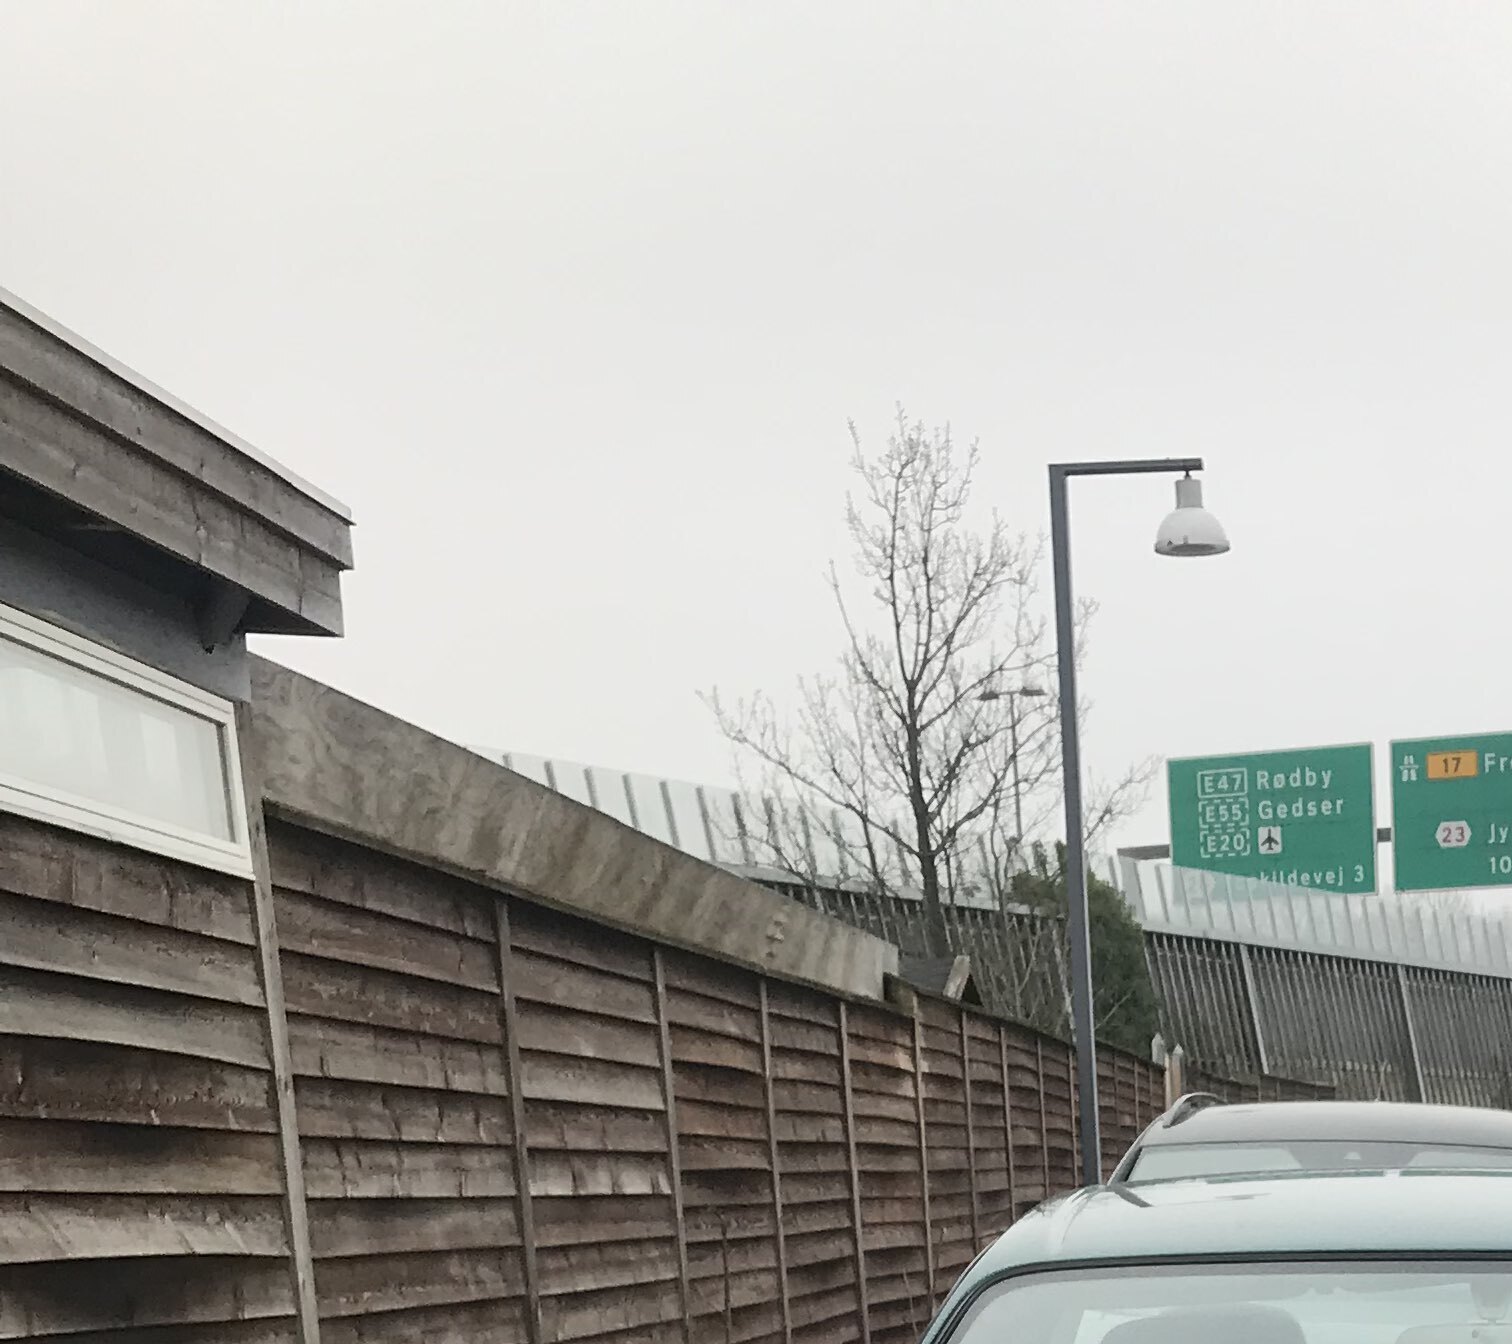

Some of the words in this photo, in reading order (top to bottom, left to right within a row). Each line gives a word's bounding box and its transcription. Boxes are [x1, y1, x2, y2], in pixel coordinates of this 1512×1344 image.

[1442, 757, 1462, 774] 17
[1203, 774, 1243, 793] E47
[1256, 767, 1332, 790] Rødby
[1205, 804, 1243, 823] E55
[1258, 797, 1344, 820] Gedser
[1207, 834, 1245, 852] E20
[1442, 826, 1465, 844] 23
[1260, 865, 1344, 887] kildevej
[1354, 864, 1365, 882] 3
